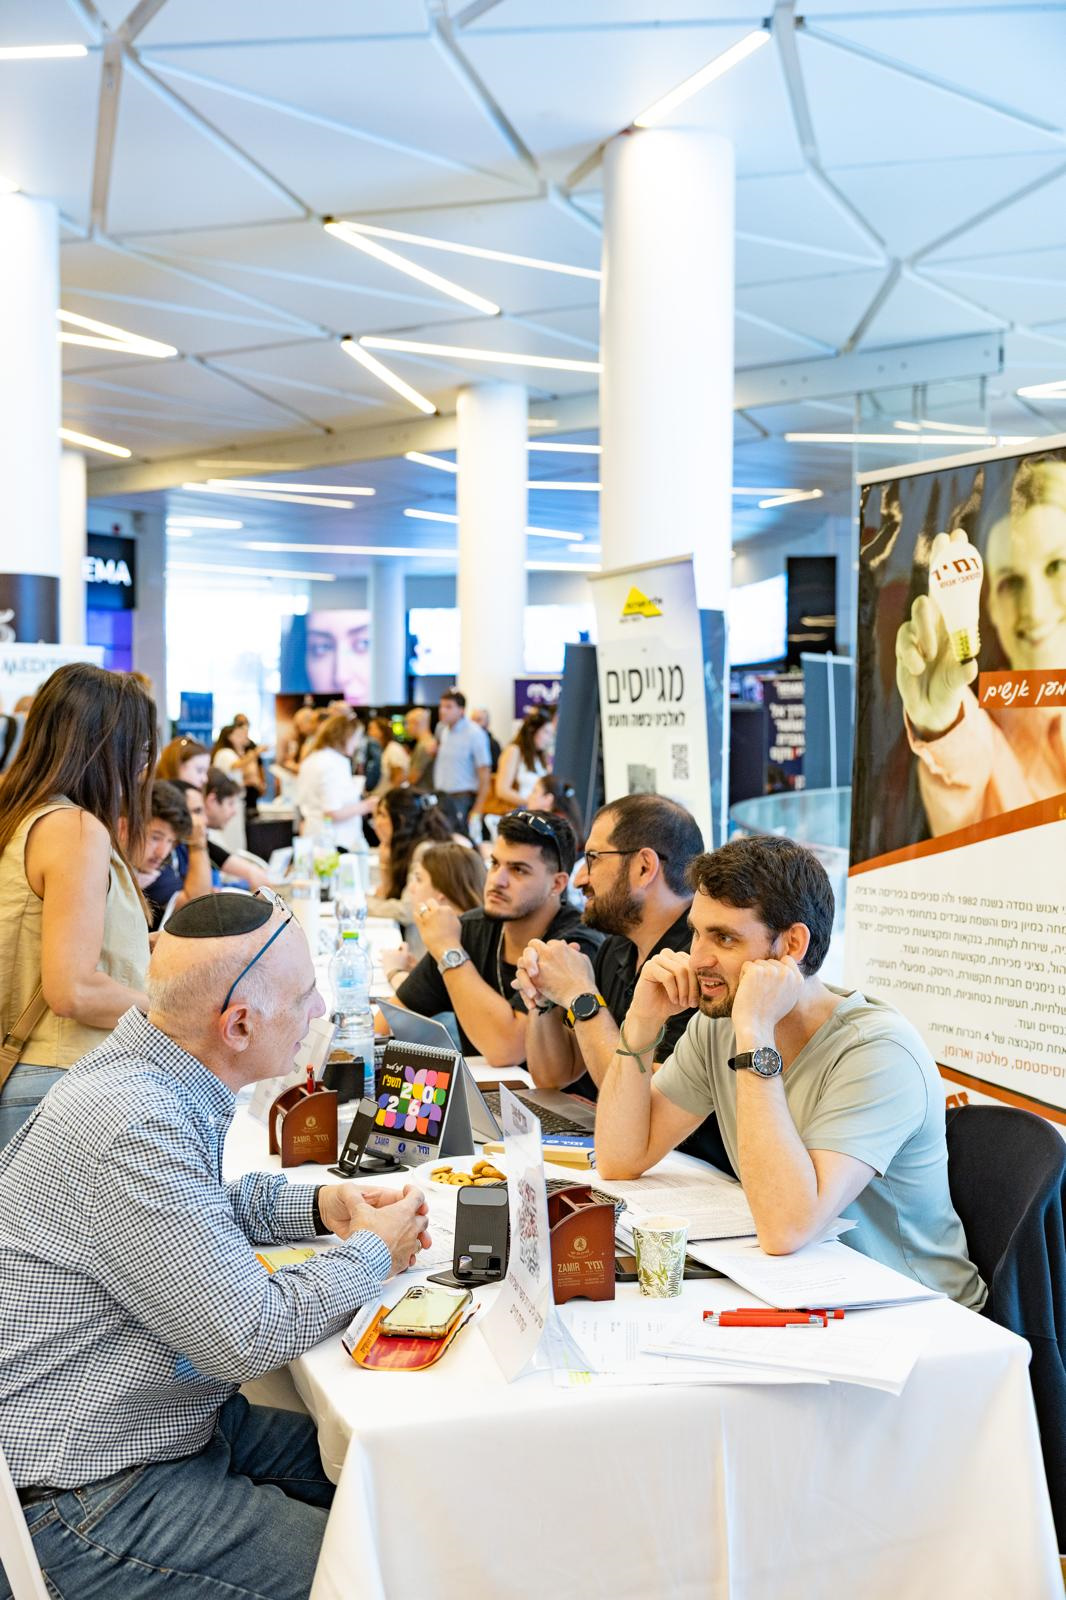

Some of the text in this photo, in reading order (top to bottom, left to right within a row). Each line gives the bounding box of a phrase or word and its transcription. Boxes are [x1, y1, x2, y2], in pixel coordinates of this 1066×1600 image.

[931, 557, 979, 581] זמיר
[606, 665, 684, 704] מגייסים
[983, 679, 1030, 706] אנשים
[879, 888, 908, 899] בפריסה
[911, 891, 940, 902] סניפים
[941, 892, 955, 903] ולה
[958, 895, 978, 906] 1982
[980, 897, 1004, 908] בשנת
[1006, 900, 1033, 911] נוסדה
[906, 908, 938, 920] בתחומי
[1036, 903, 1059, 914] אנוש
[940, 912, 967, 924] עובדים
[969, 915, 998, 927] והשמת
[912, 927, 951, 941] ומקצועות
[953, 932, 983, 945] בנקאות
[921, 946, 949, 958] תעופה
[1021, 940, 1048, 953] שירות
[951, 951, 986, 964] מקצועות
[900, 960, 926, 974] מפעלי
[1024, 959, 1044, 972] נציגי
[994, 975, 1023, 988] חברות
[926, 983, 951, 996] חברות
[994, 995, 1029, 1009] תעשיות
[955, 1026, 981, 1039] חברות
[984, 1033, 990, 1041] 4
[991, 1031, 1005, 1044] של
[1007, 1036, 1043, 1052] מקבוצה
[976, 1050, 1008, 1067] פולטק
[292, 1135, 311, 1145] ZAMIR
[557, 1262, 581, 1273] ZAMIR
[584, 1260, 605, 1270] זמיר
